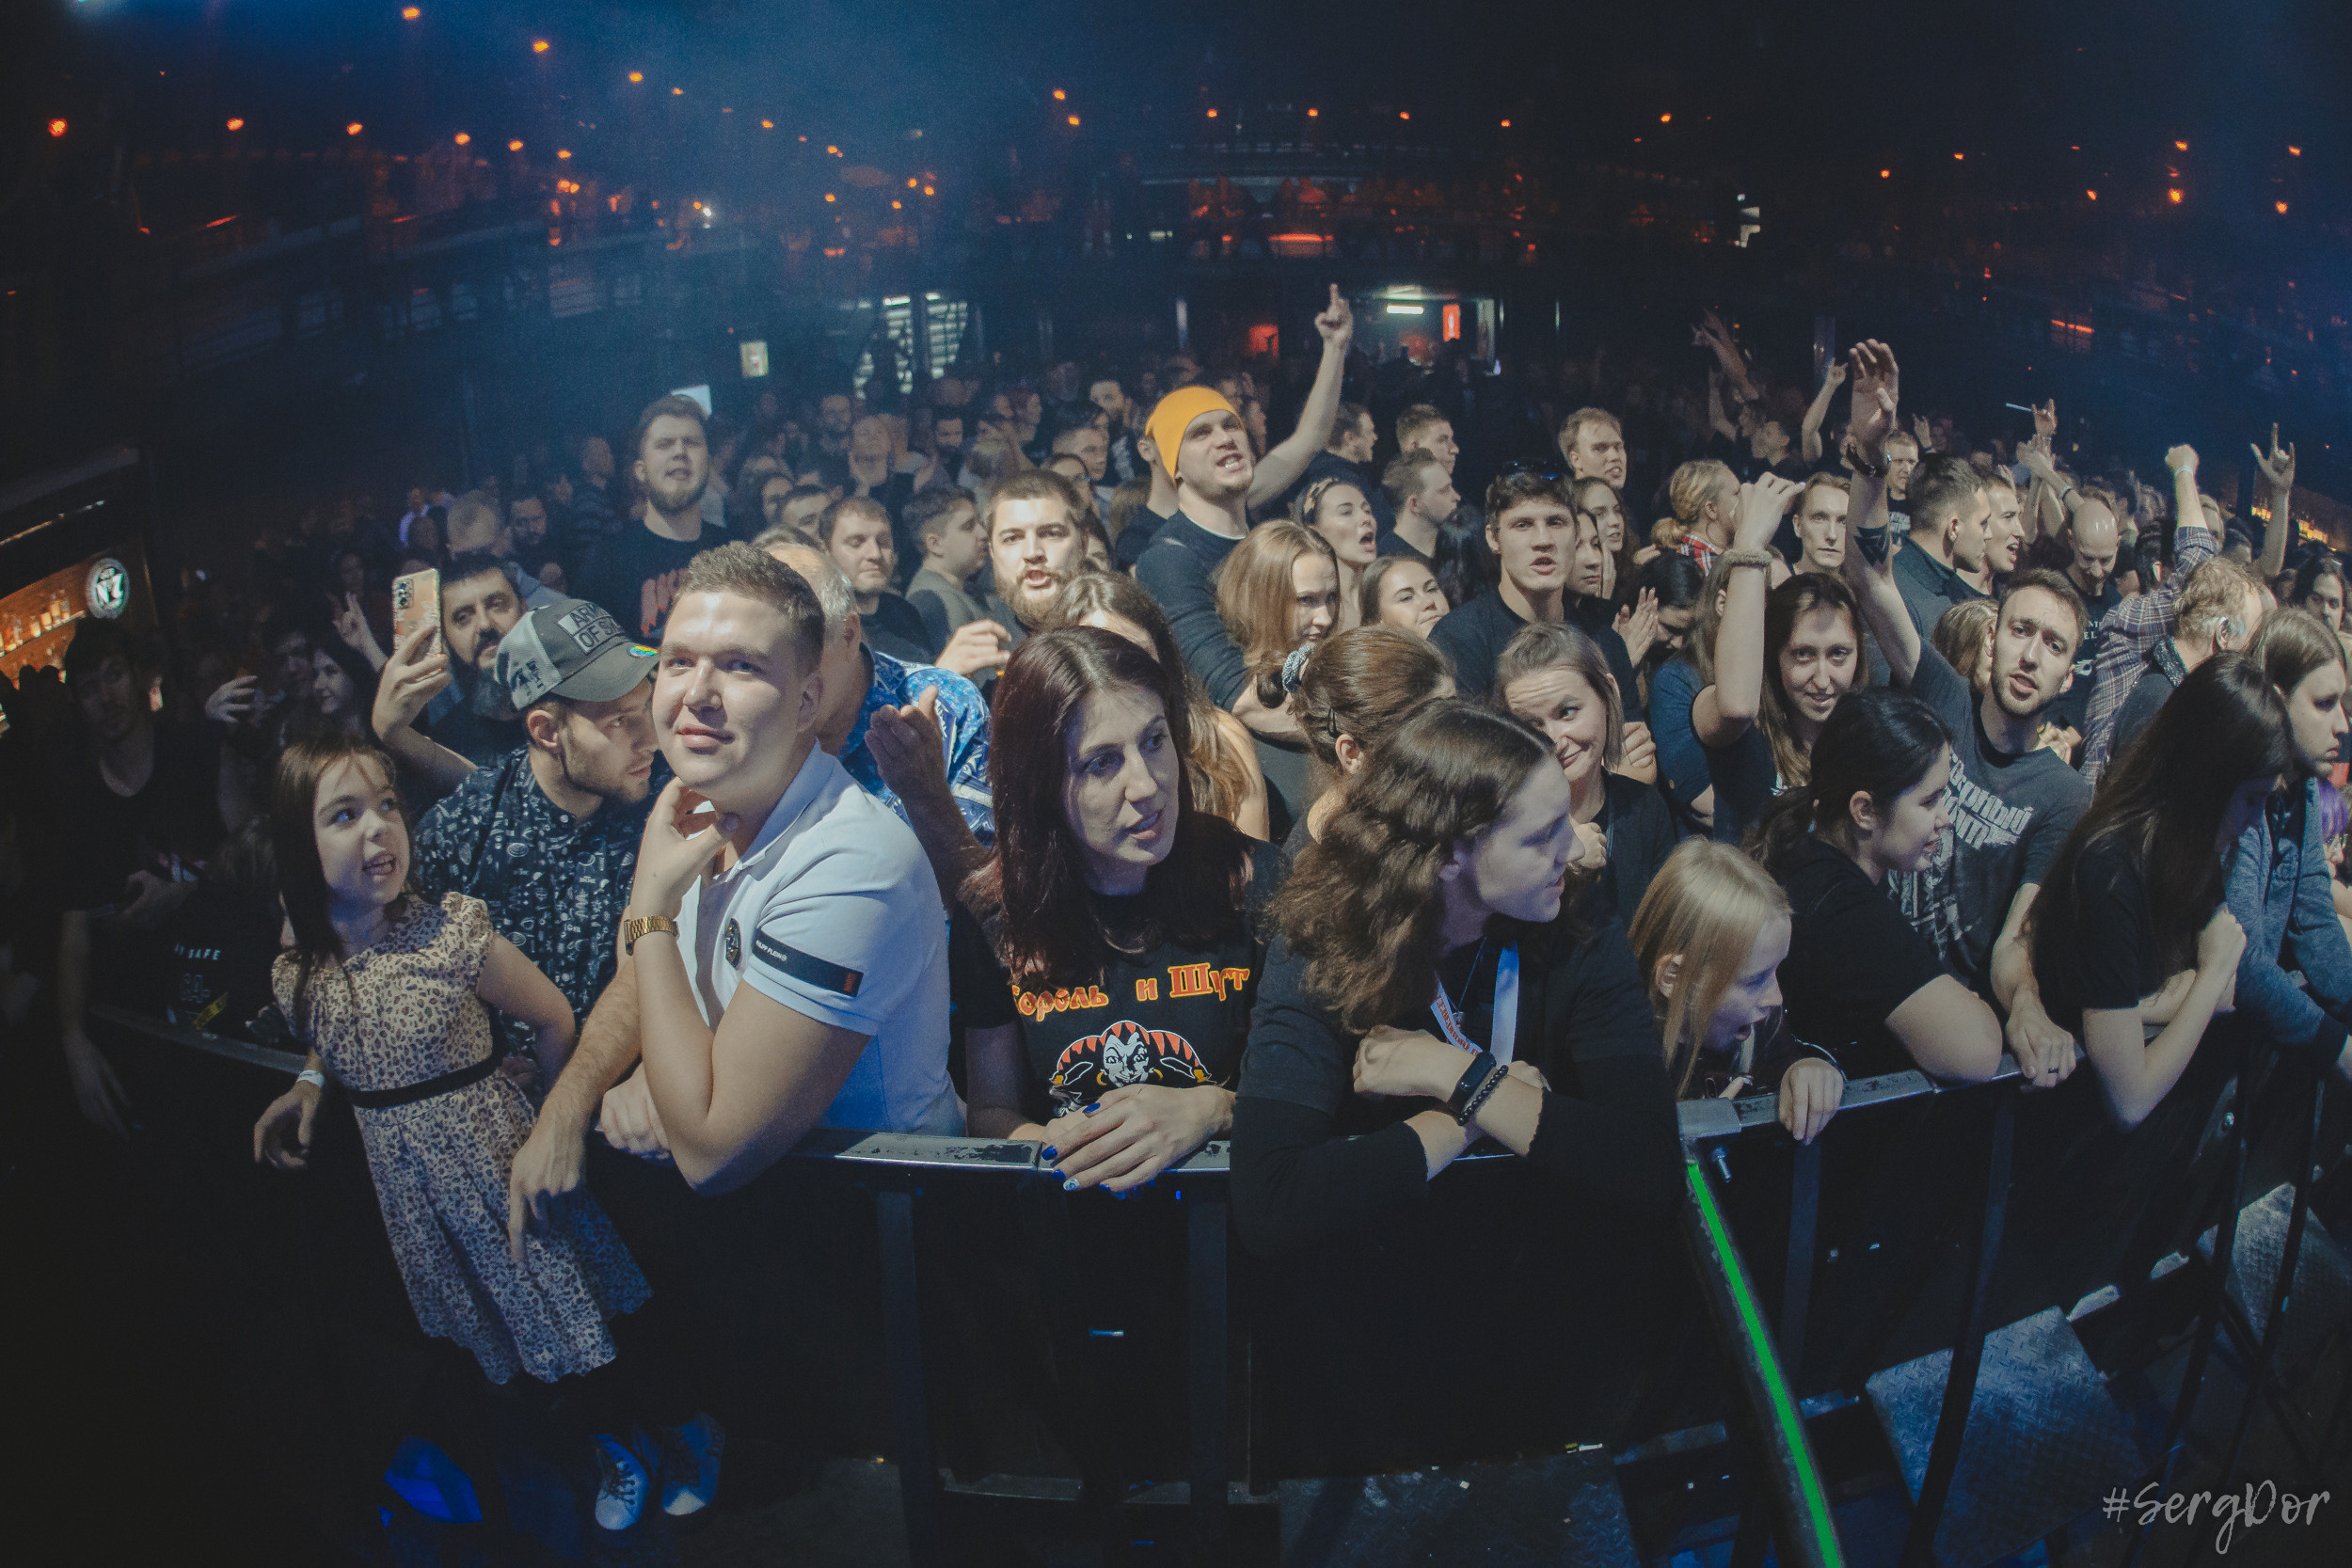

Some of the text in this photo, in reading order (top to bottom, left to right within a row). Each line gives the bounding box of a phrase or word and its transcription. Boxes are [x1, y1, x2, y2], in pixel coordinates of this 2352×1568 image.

[579, 625, 601, 648] OF
[1136, 977, 1158, 1002] и
[1168, 962, 1250, 1002] Шут
